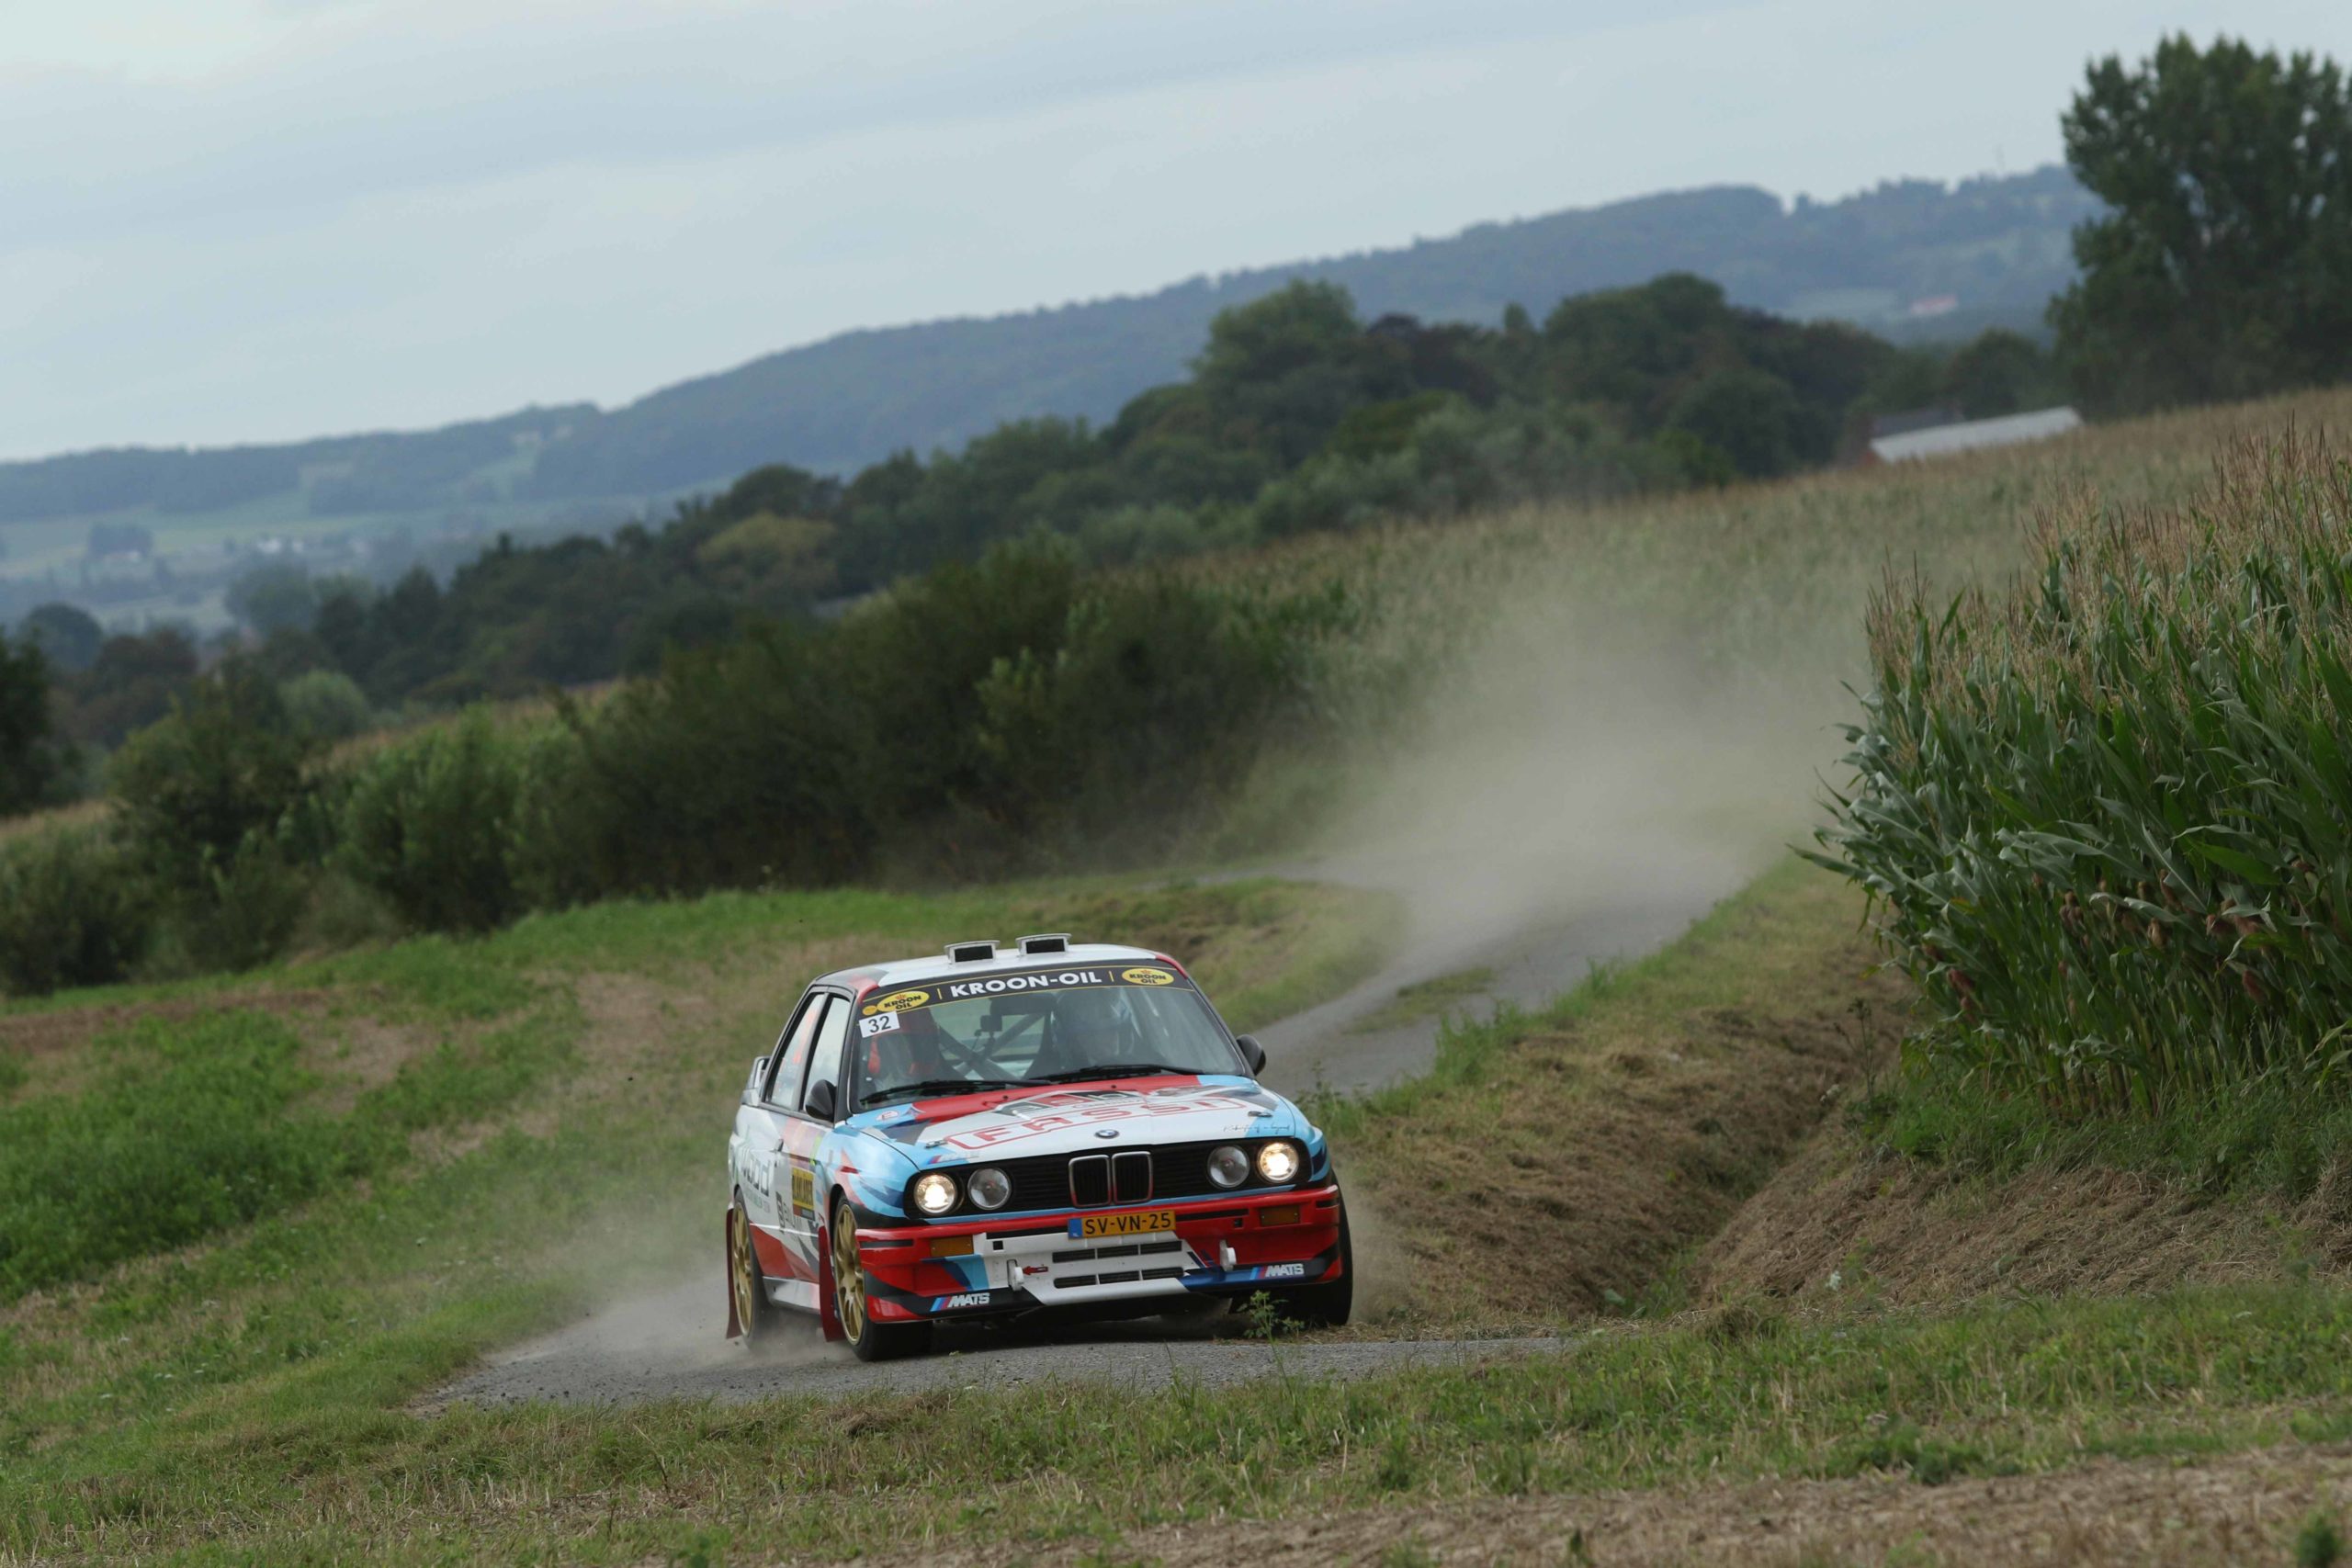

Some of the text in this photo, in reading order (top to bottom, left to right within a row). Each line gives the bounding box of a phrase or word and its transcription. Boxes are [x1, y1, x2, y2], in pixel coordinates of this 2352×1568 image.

[950, 971, 1102, 998] KROON-OIL
[884, 995, 922, 1009] KROON
[895, 1002, 912, 1010] OIL
[868, 1015, 891, 1033] 32
[1085, 1212, 1171, 1235] SV-VN-25
[1265, 1263, 1305, 1278] MATS
[947, 1292, 990, 1308] MATS
